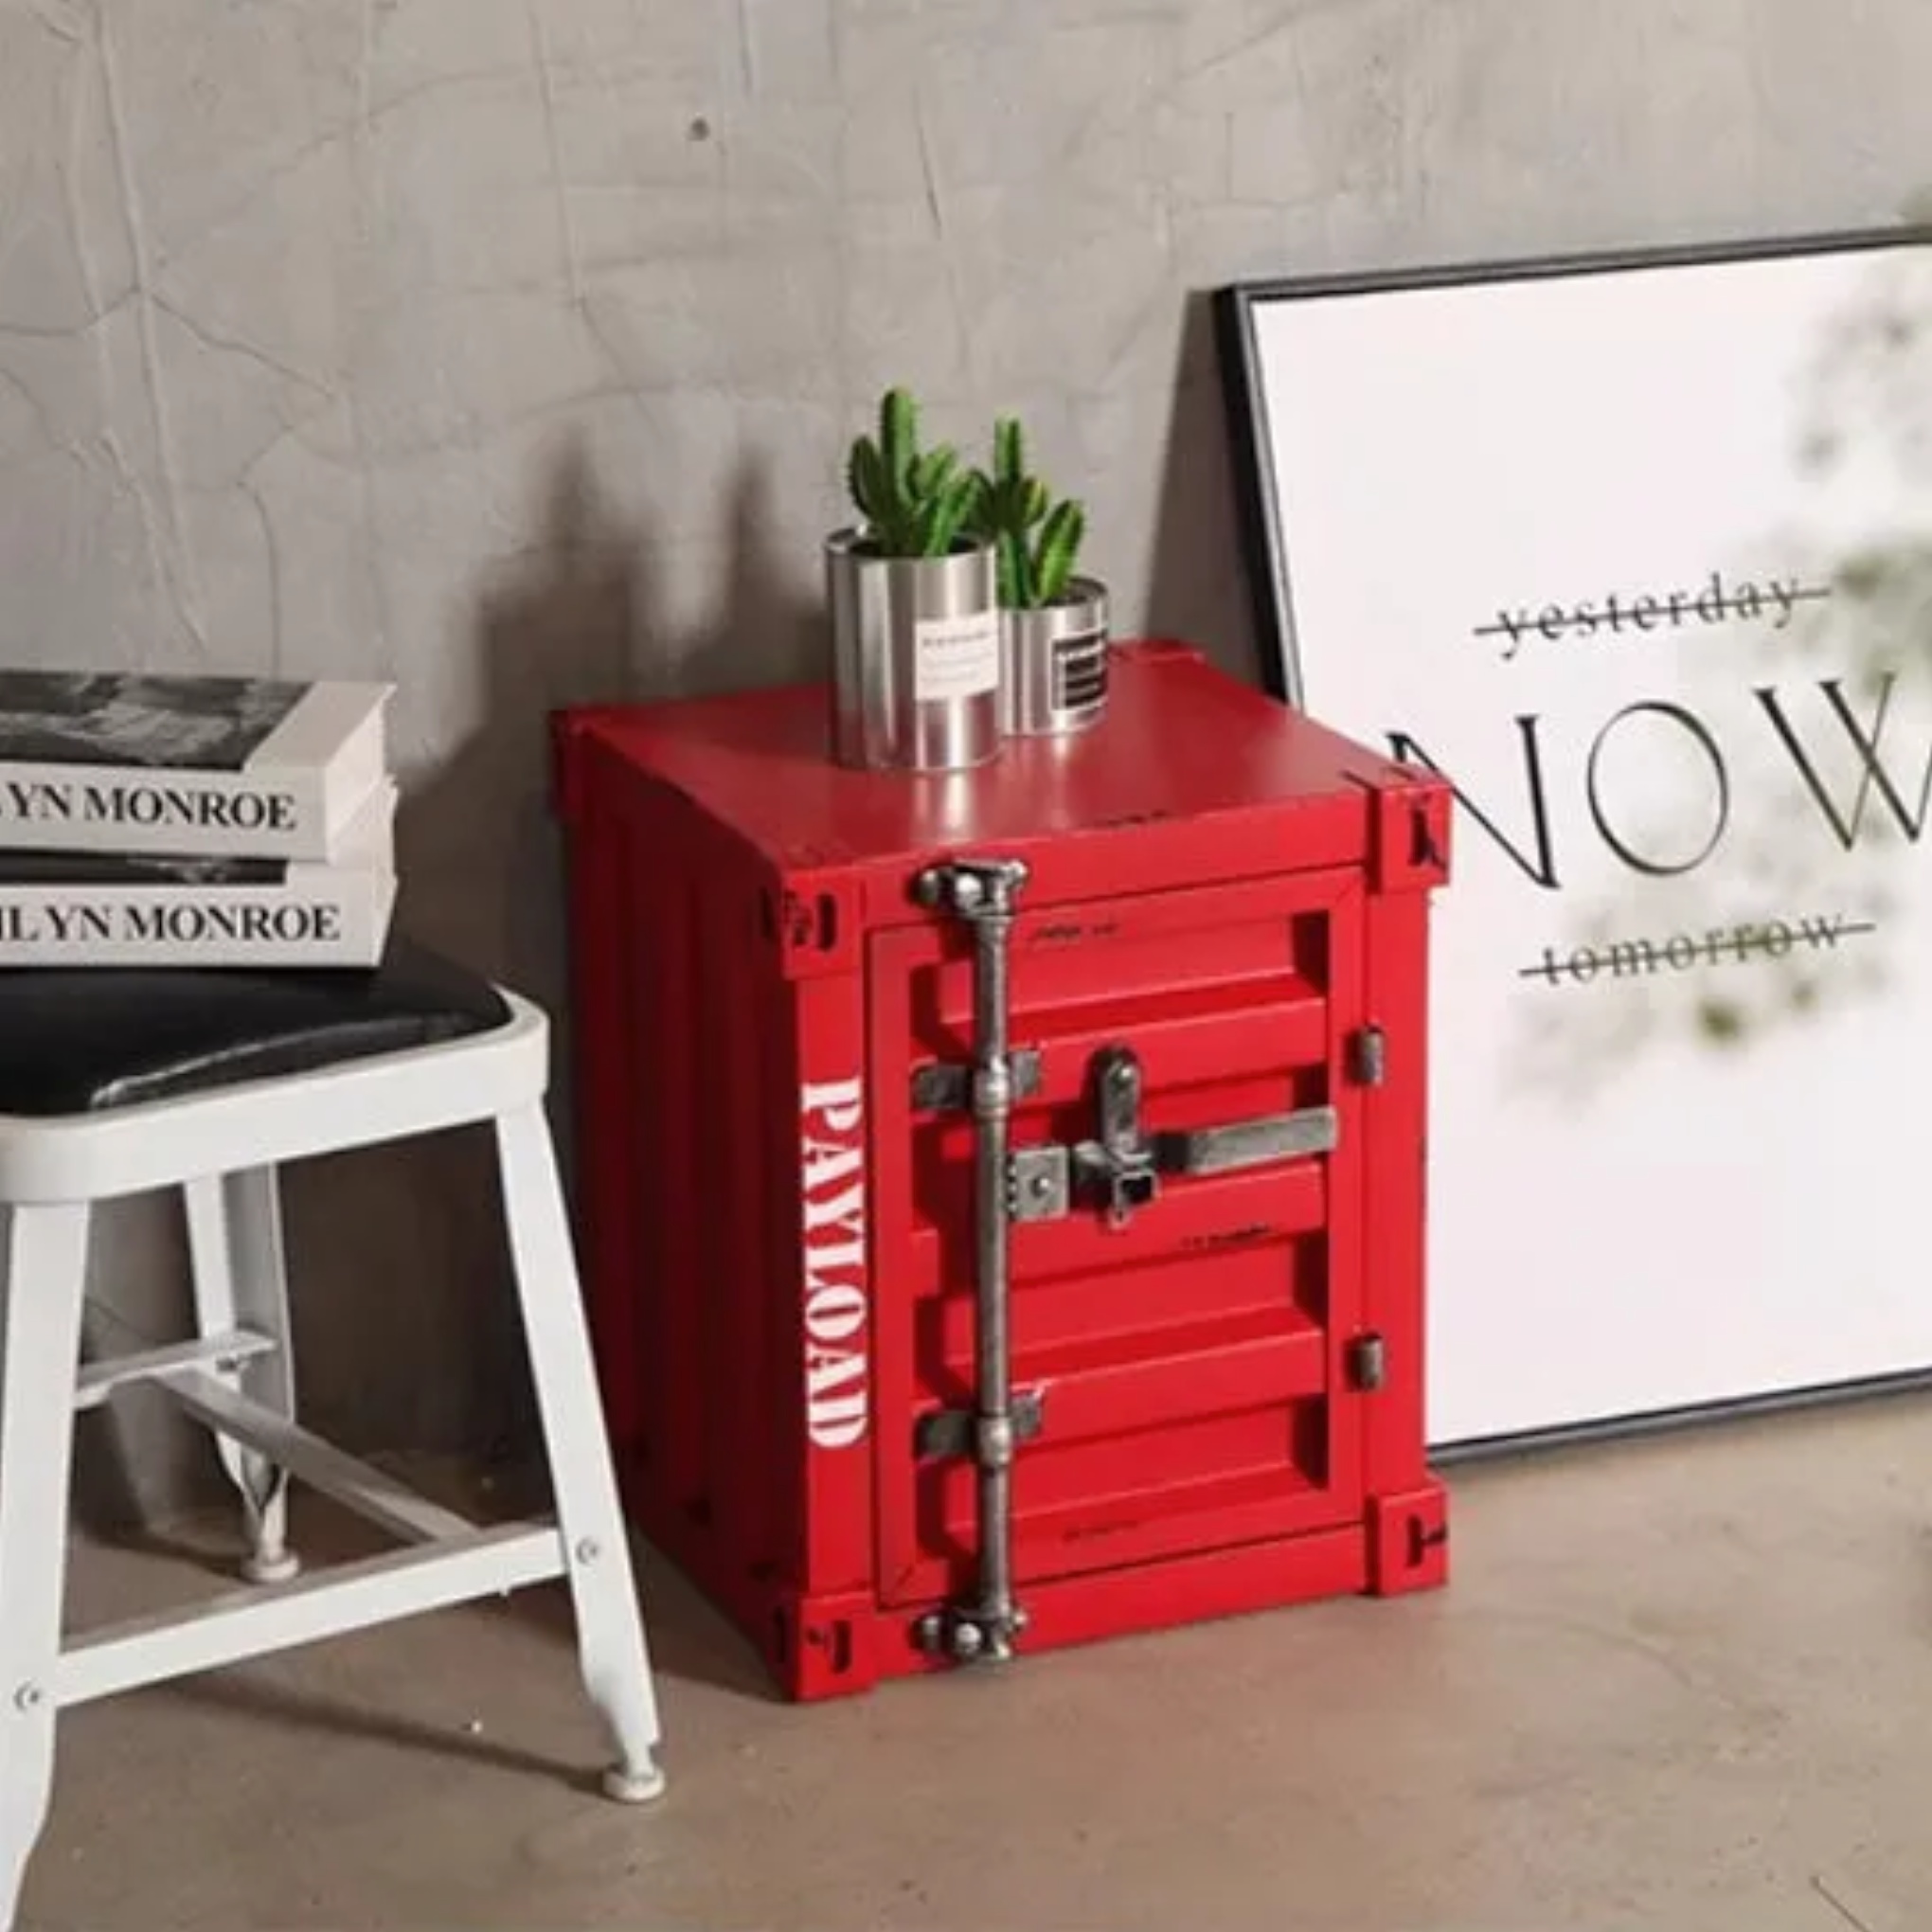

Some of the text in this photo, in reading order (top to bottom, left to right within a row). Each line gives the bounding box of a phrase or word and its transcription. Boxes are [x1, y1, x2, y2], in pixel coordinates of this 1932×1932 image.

[1496, 571, 1803, 660] yesterday
[0, 781, 296, 831] YN MONROE
[1385, 671, 1932, 889] NOW
[124, 904, 341, 941] MONROE
[1541, 911, 1846, 987] tomorrow
[801, 1076, 868, 1449] PAYLOAD
